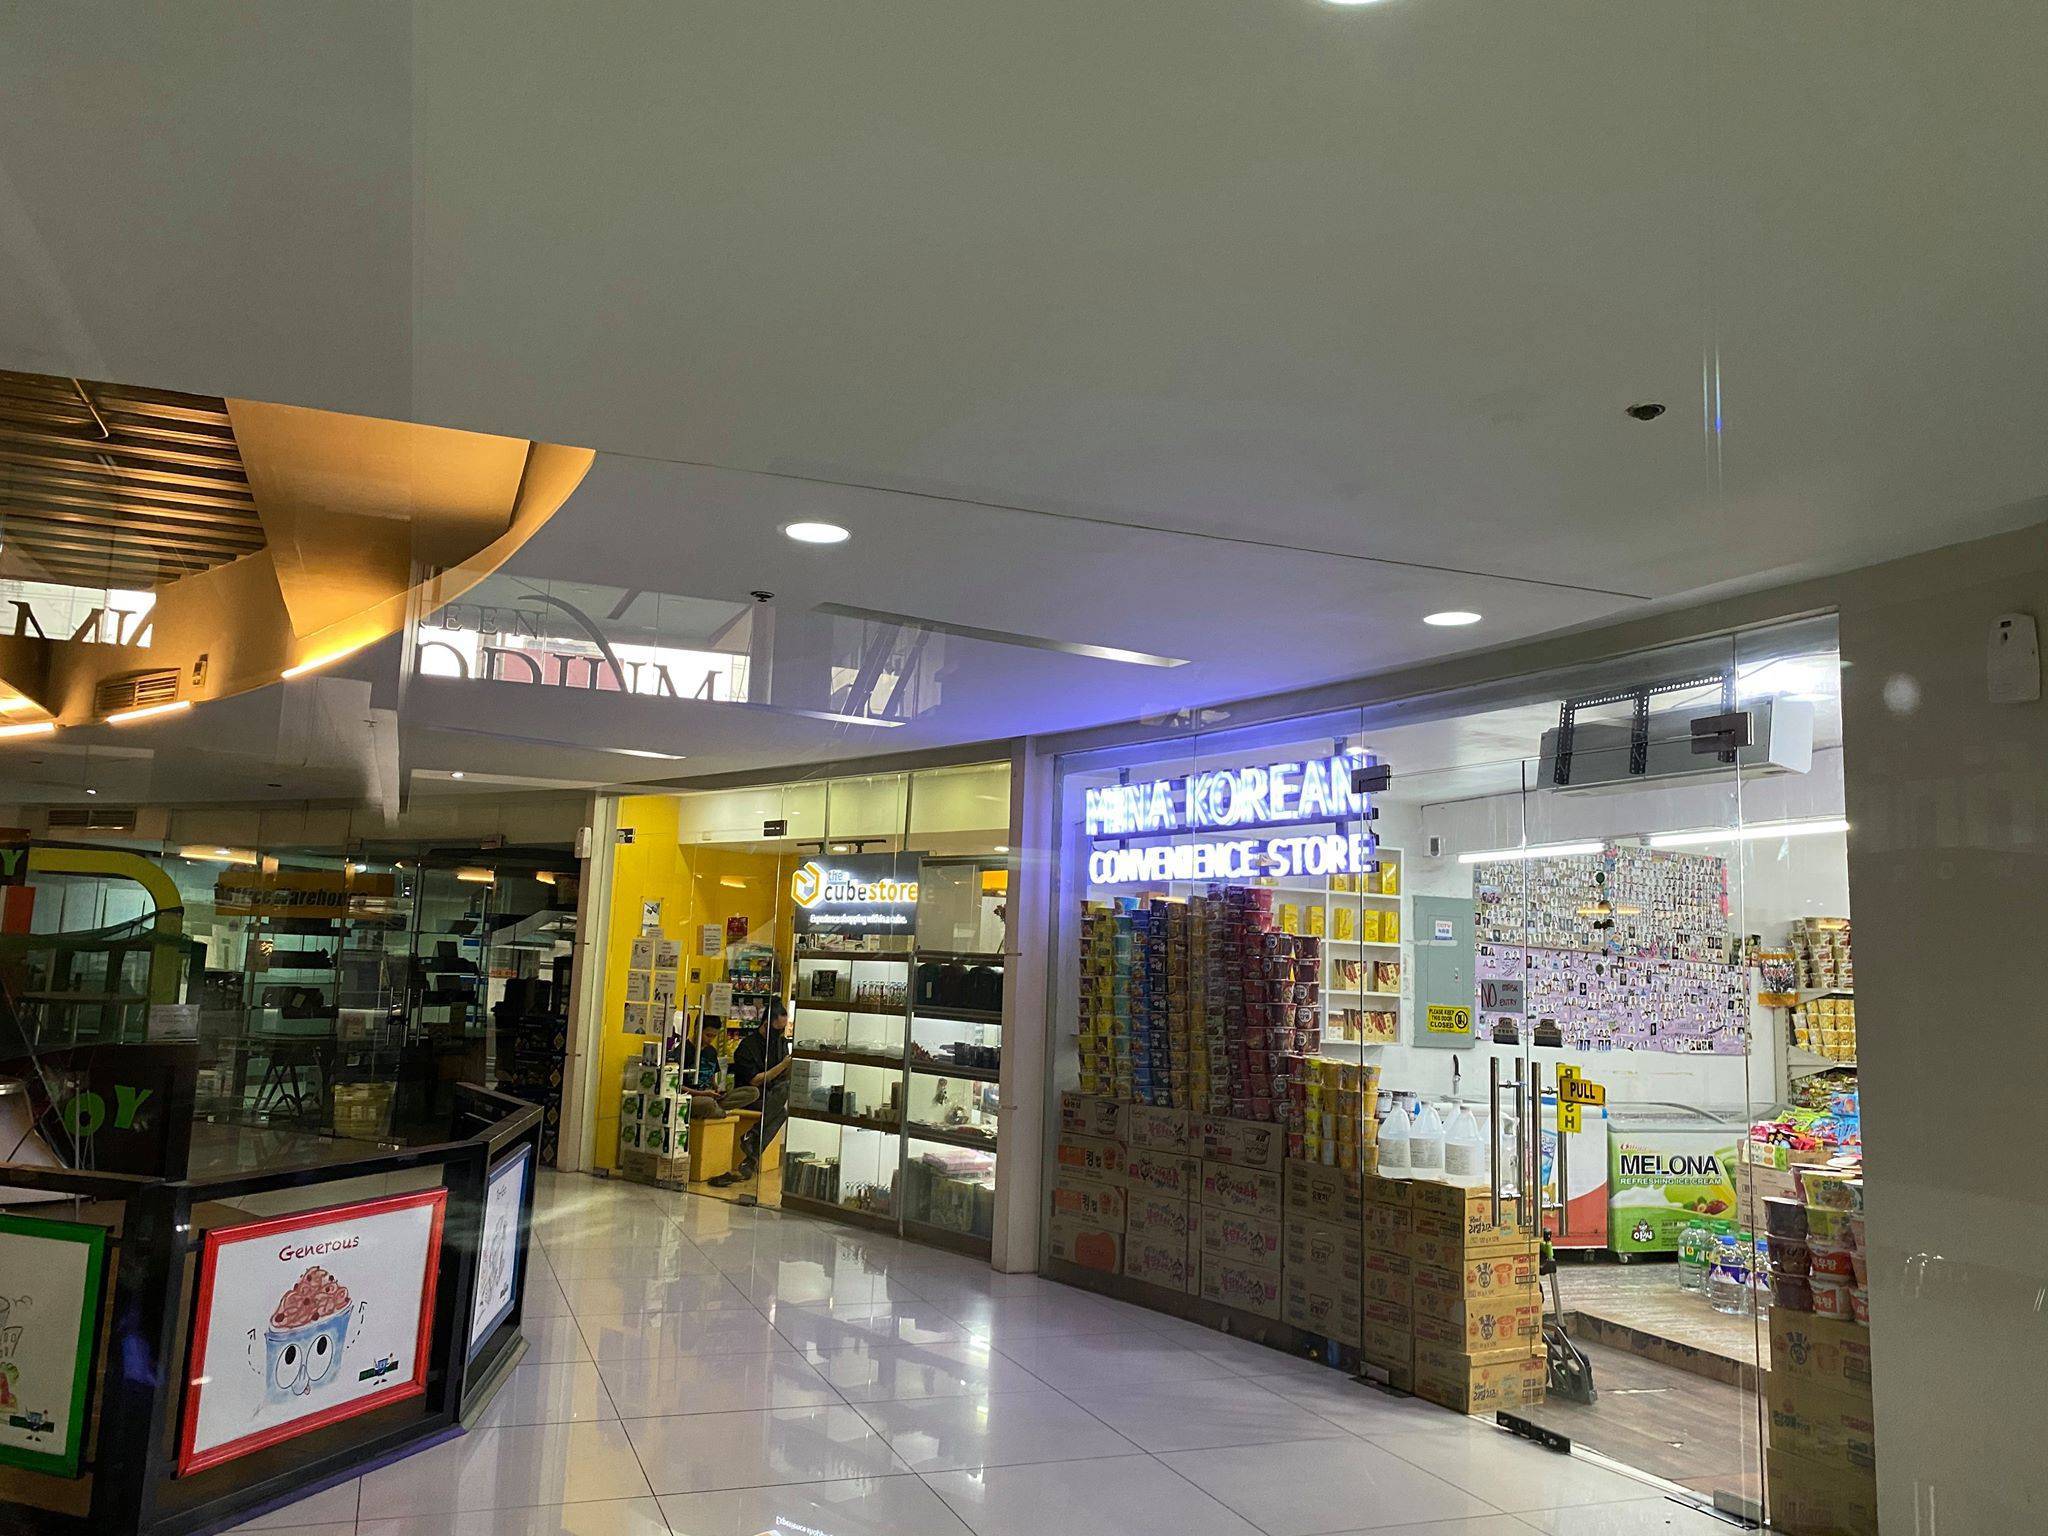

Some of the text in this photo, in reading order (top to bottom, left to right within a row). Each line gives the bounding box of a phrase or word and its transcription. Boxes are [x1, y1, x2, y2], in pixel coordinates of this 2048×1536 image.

[1086, 756, 1369, 835] MINA KOREAN
[1088, 833, 1372, 884] CONVENIENCE STORE
[828, 869, 843, 882] the
[825, 880, 918, 902] cubestore
[1481, 983, 1497, 1008] NO
[1500, 999, 1517, 1007] ENTRY
[1570, 1081, 1595, 1099] PULL
[1620, 1154, 1720, 1176] MELONA
[278, 1234, 360, 1262] Generous
